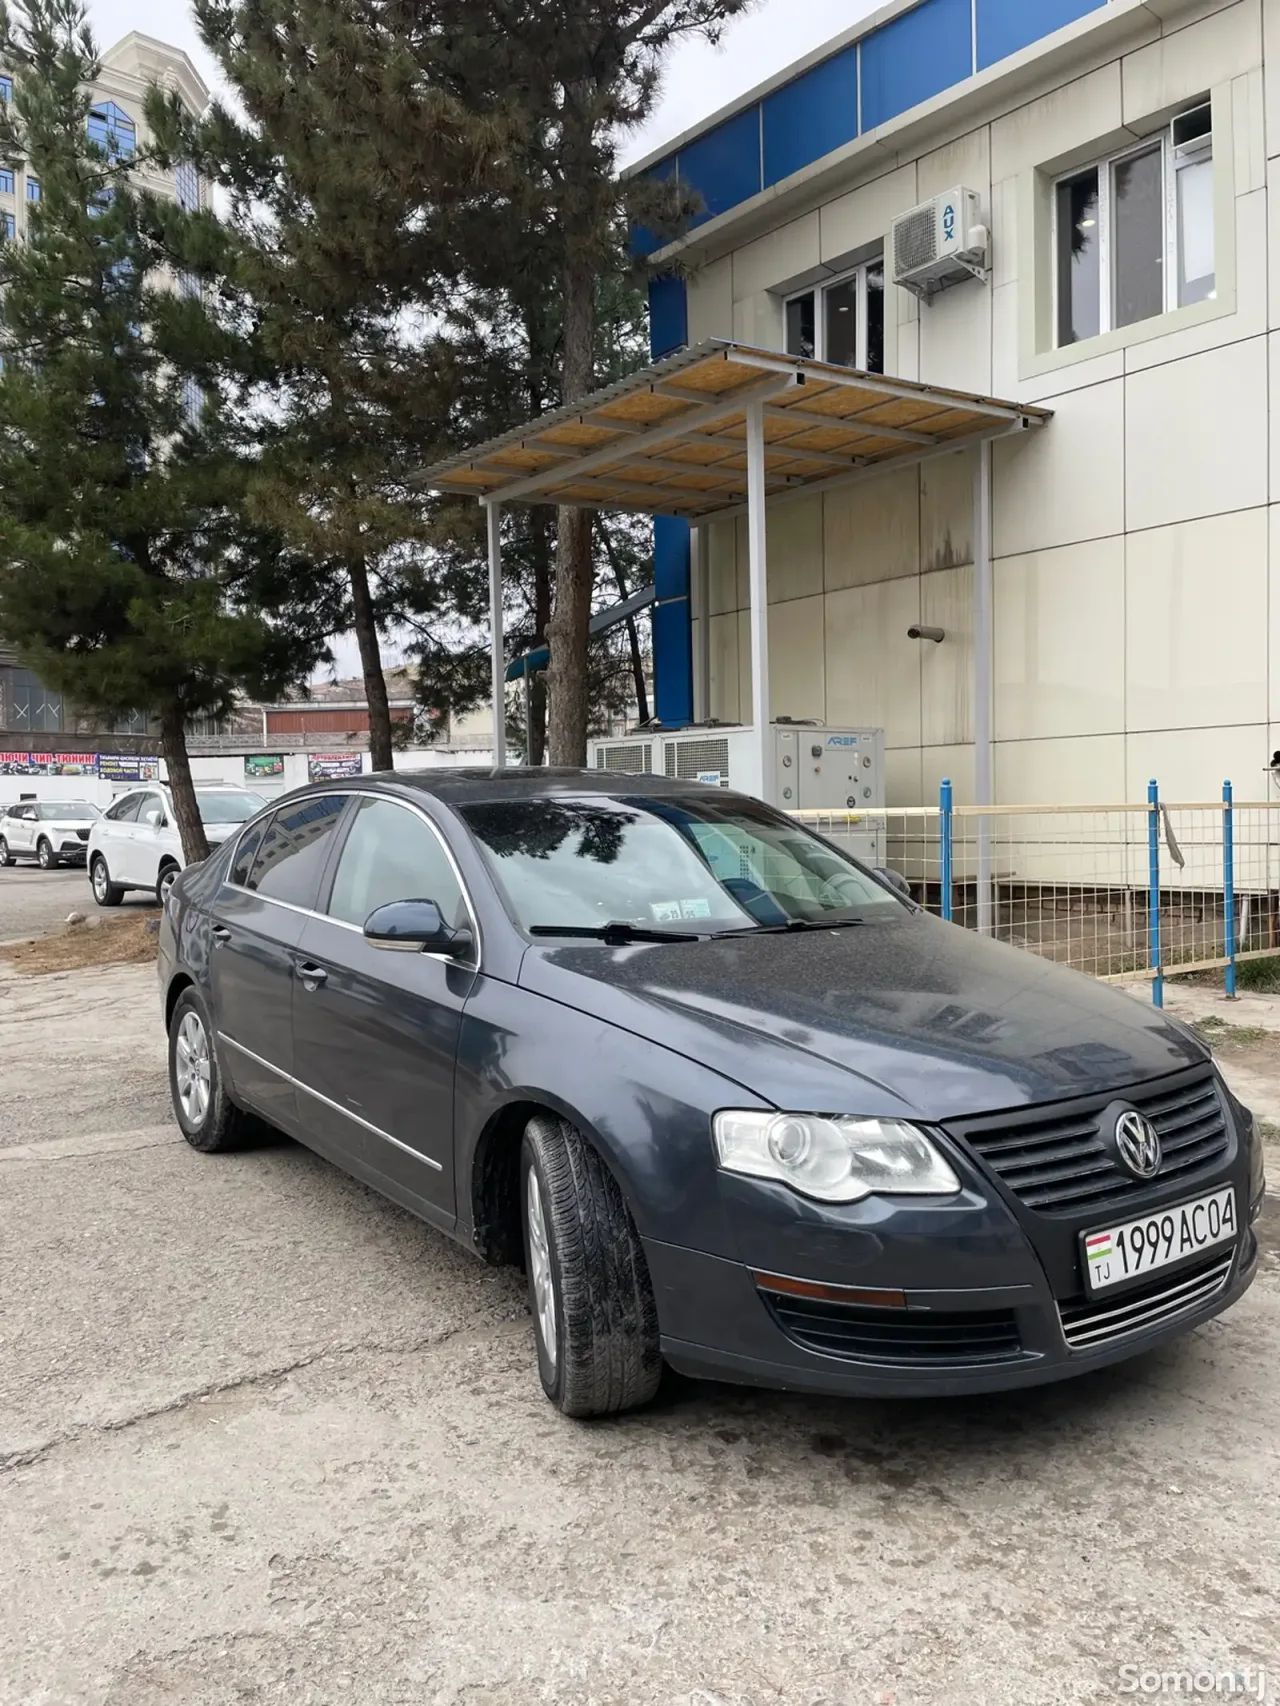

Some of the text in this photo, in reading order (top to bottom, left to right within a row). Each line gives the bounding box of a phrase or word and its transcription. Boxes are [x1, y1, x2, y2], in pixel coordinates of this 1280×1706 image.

[943, 205, 954, 241] AUX
[827, 736, 858, 746] AREF
[1116, 1192, 1235, 1274] 1999AC04
[1094, 1262, 1111, 1283] TJ
